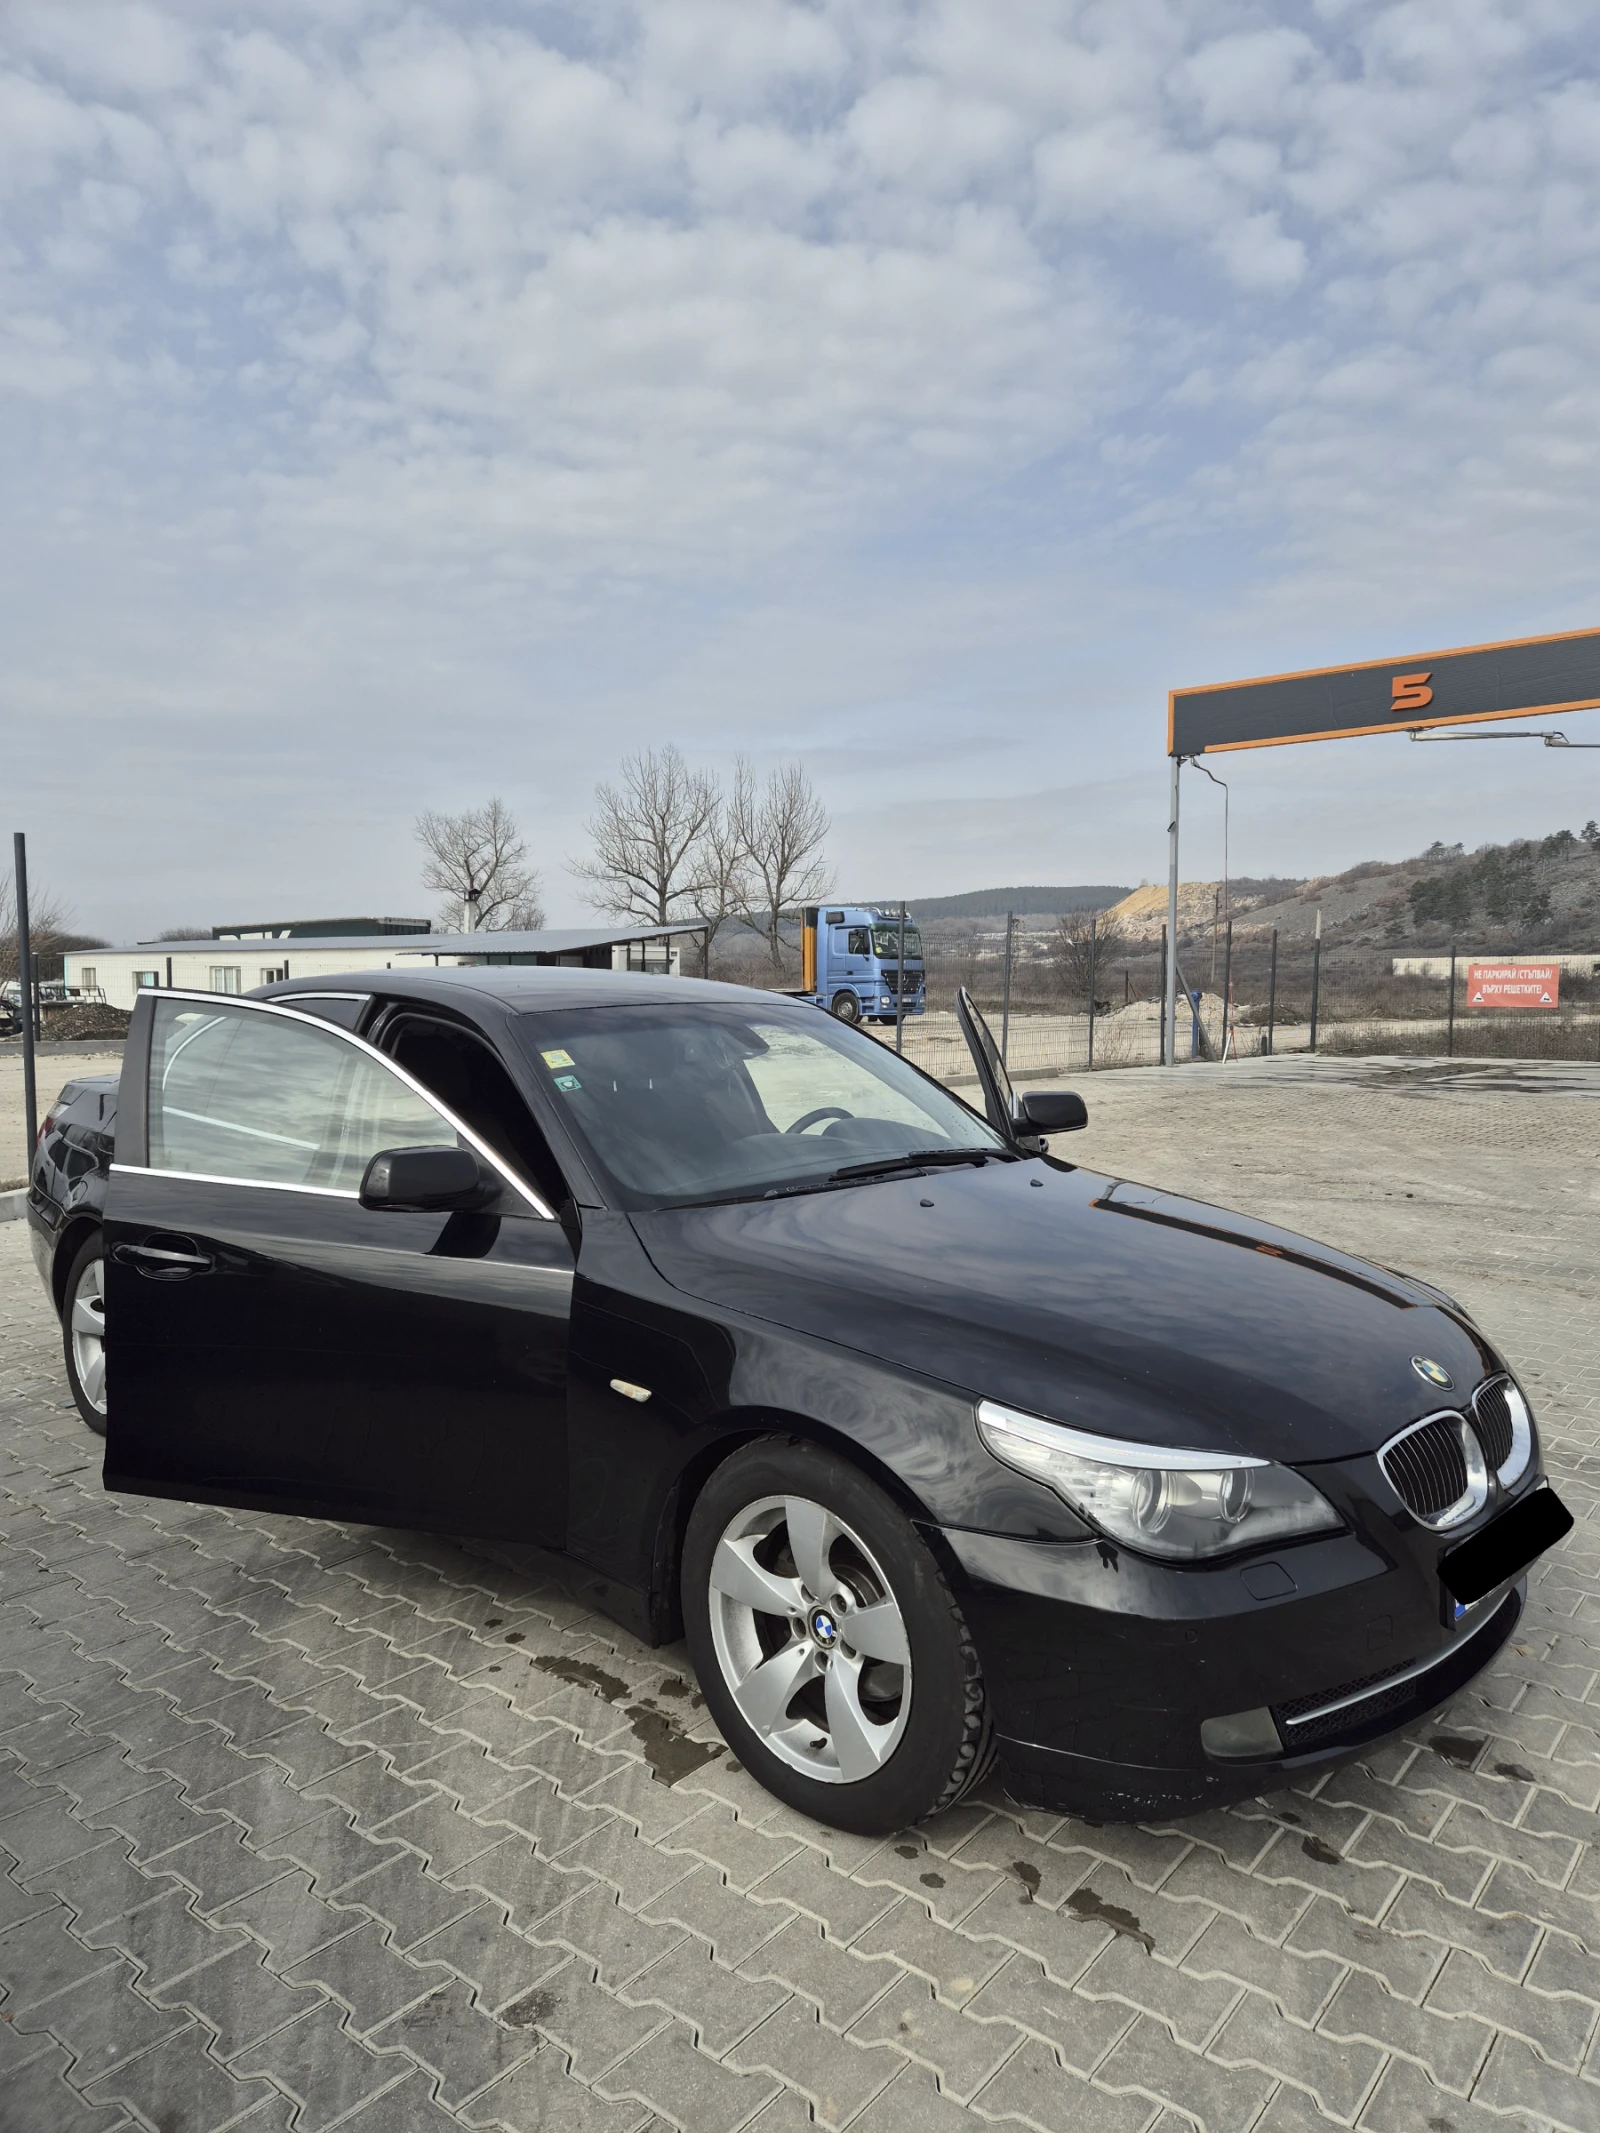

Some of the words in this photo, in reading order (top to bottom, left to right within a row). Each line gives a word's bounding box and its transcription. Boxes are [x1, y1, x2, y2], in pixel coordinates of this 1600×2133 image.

[1391, 672, 1433, 711] 5
[1474, 969, 1482, 979] НЕ
[1483, 968, 1517, 979] ПАРКИРАЙ
[1482, 984, 1503, 994] ВЪРХУ
[1504, 984, 1542, 994] РЕШЕТКИТЕ!
